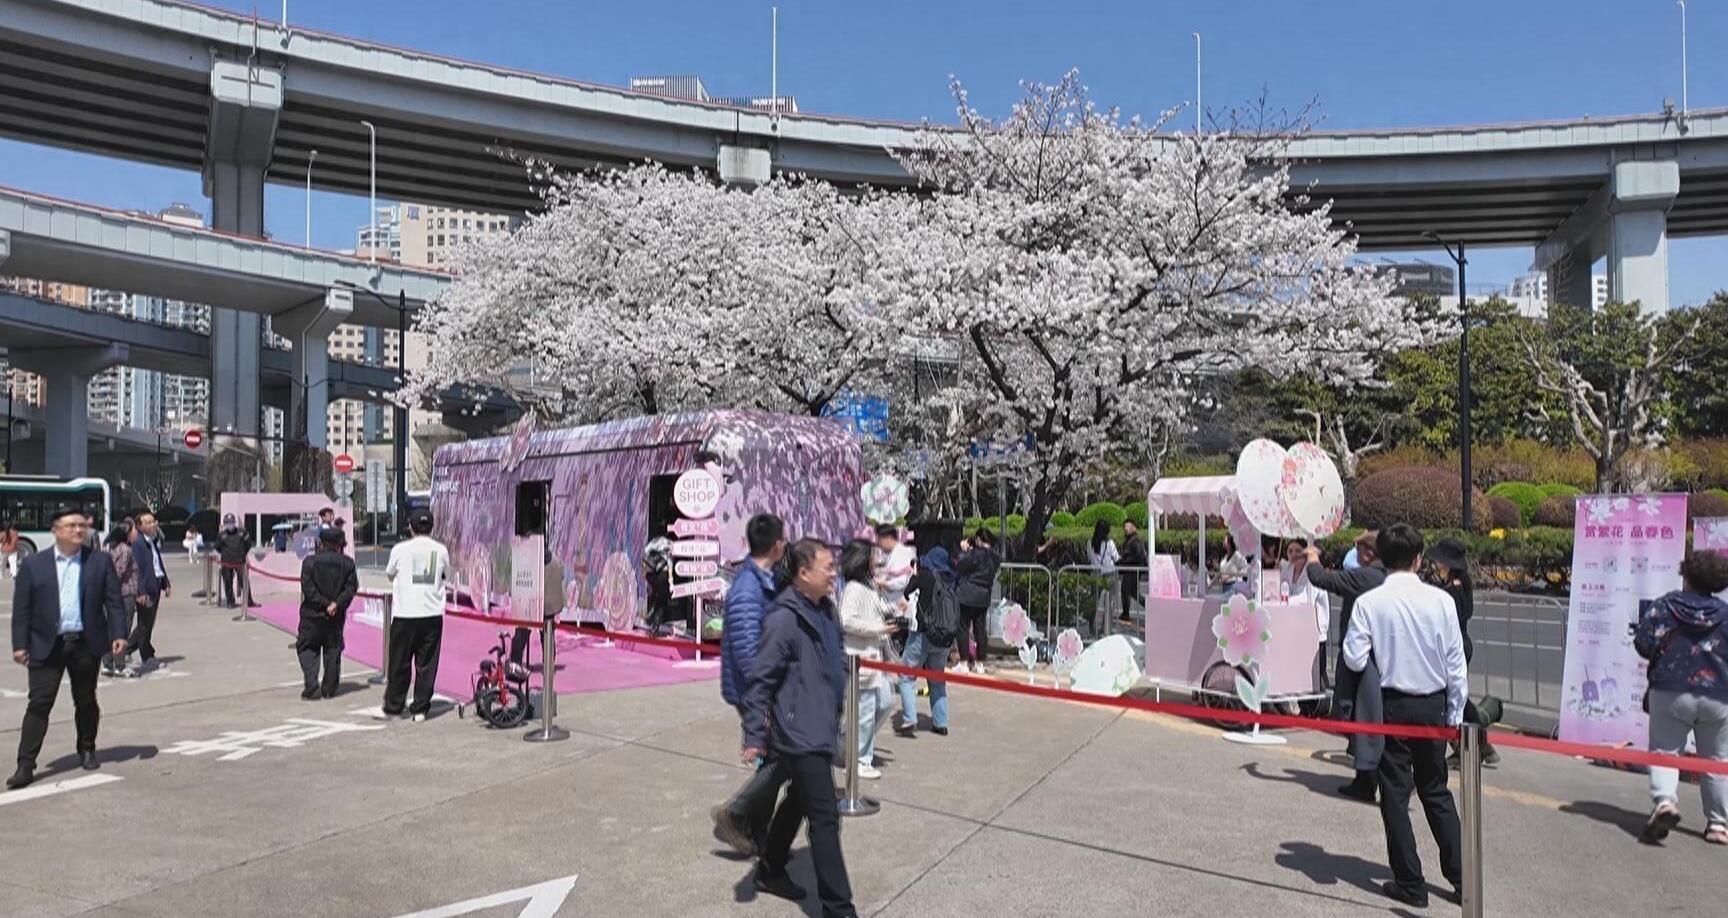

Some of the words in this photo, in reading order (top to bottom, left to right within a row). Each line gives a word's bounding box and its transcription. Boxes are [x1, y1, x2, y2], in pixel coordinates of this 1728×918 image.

[682, 479, 710, 490] GIFT
[679, 490, 715, 503] SHOP
[1584, 524, 1624, 539] 赏繁花
[1630, 524, 1674, 540] 品春色
